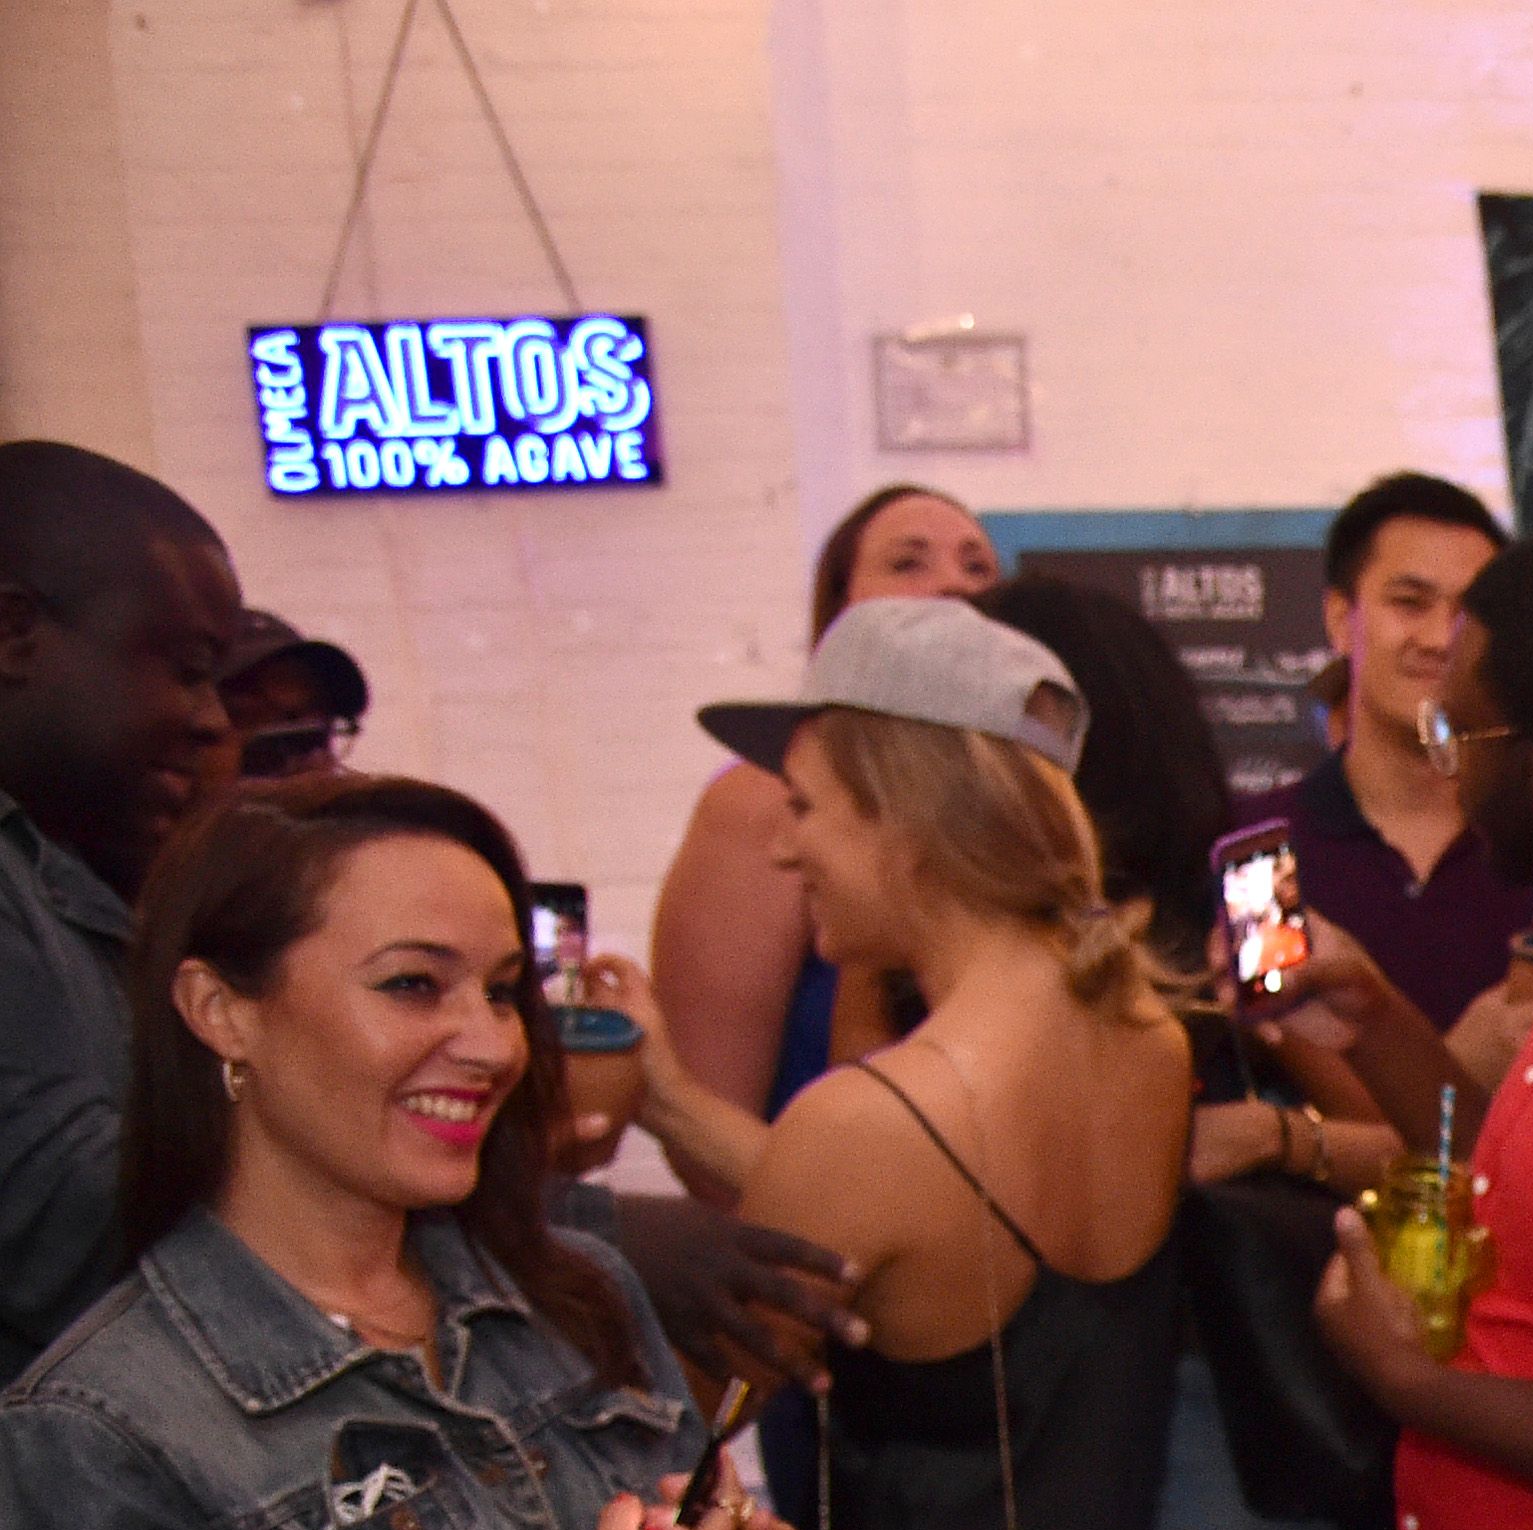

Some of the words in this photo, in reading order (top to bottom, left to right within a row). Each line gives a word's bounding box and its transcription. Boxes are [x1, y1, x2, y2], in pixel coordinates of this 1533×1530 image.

[250, 328, 321, 494] OLMECA
[317, 316, 652, 440] ALTOS
[321, 436, 471, 489] 100%
[482, 431, 649, 486] AGAVE
